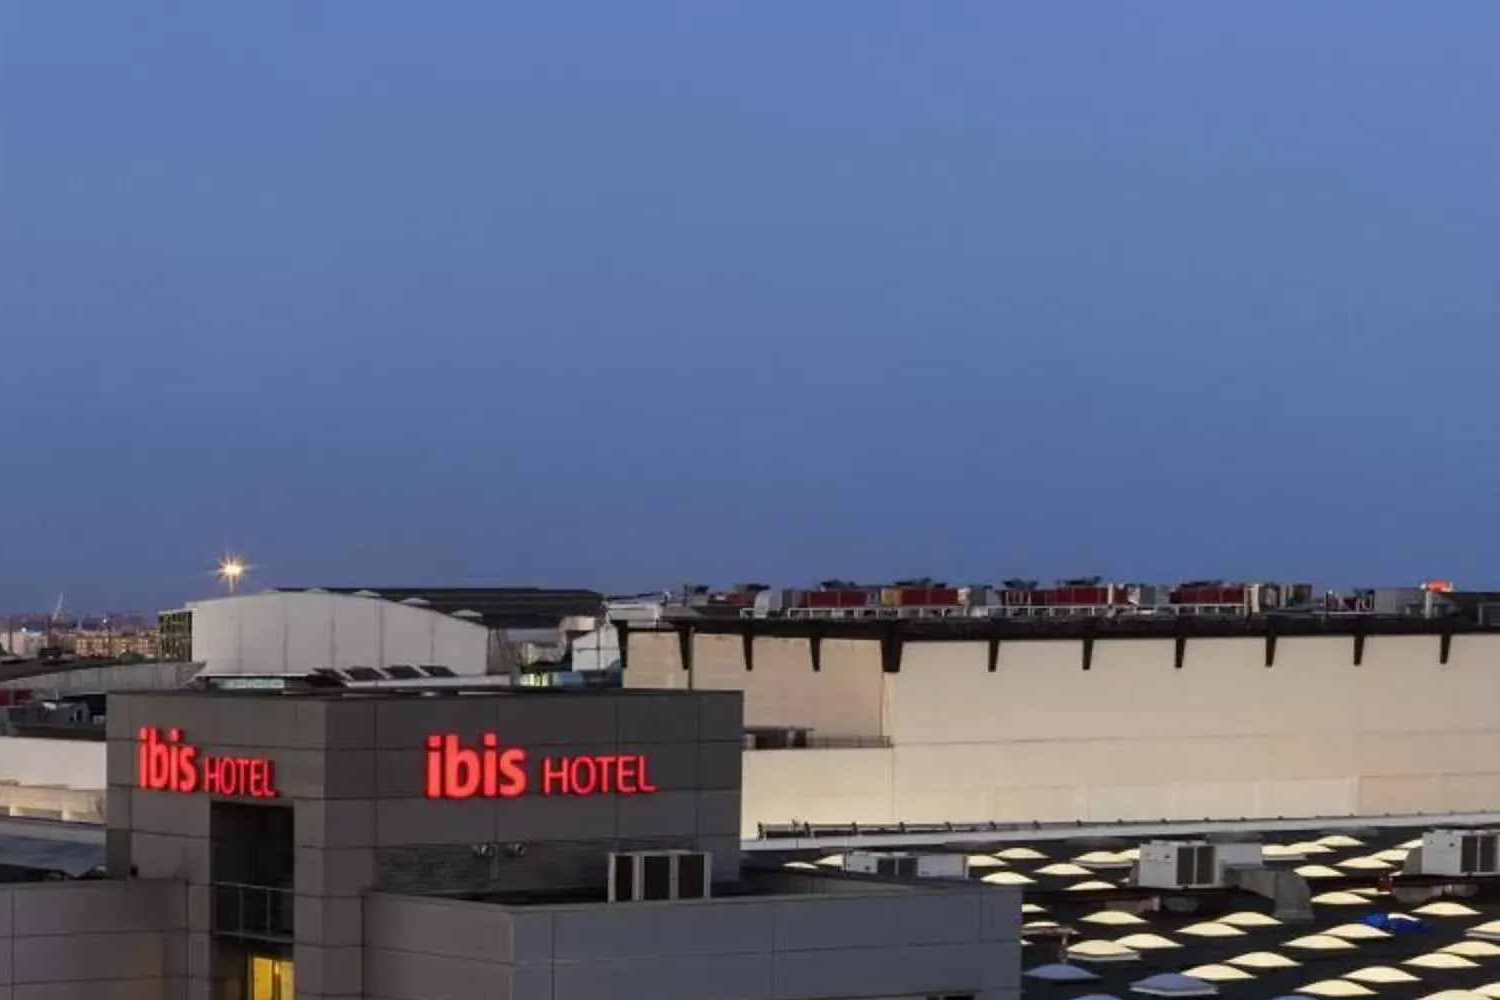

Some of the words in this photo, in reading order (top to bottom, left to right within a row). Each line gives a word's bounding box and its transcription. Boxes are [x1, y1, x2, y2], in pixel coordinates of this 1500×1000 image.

[138, 728, 198, 792] ibis
[204, 757, 277, 797] HOTEL
[425, 732, 528, 798] ibis
[543, 755, 656, 794] HOTEL
